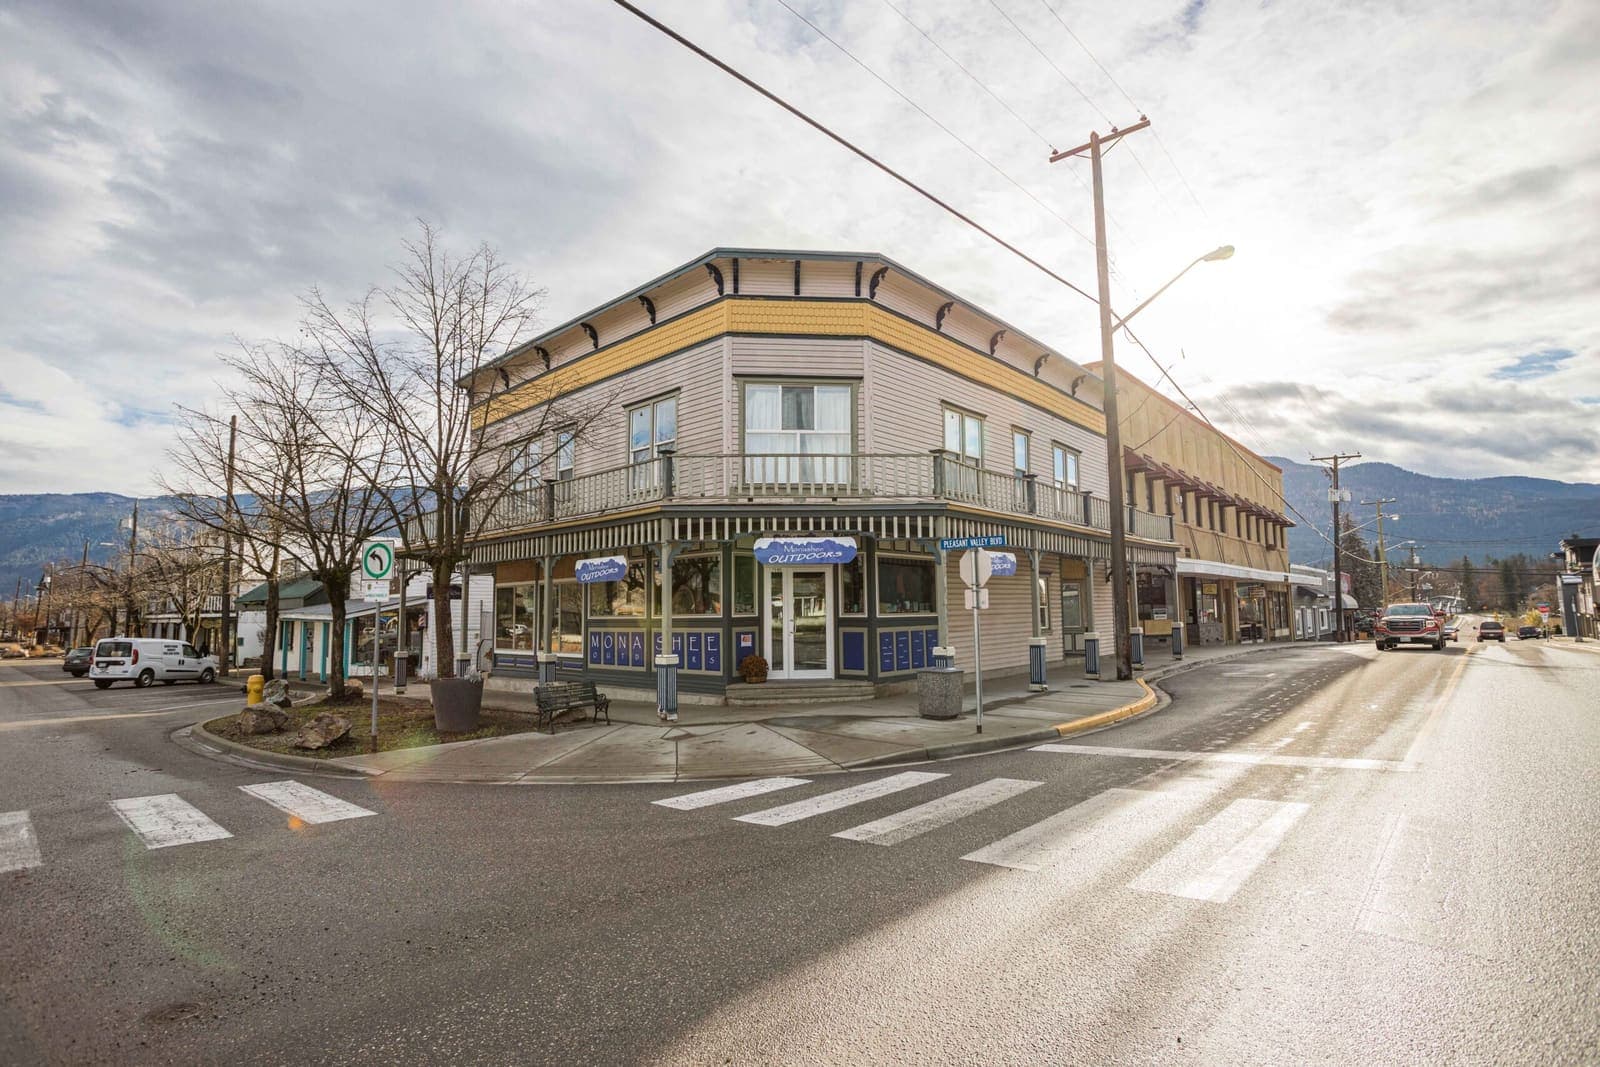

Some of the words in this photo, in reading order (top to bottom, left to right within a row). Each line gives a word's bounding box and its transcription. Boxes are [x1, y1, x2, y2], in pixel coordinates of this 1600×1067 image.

[943, 538, 968, 548] PLEASANT
[969, 537, 988, 547] VALLEY
[989, 536, 1003, 545] BLVD
[768, 551, 842, 563] OUTDOORS
[580, 567, 619, 581] OUTDOORS
